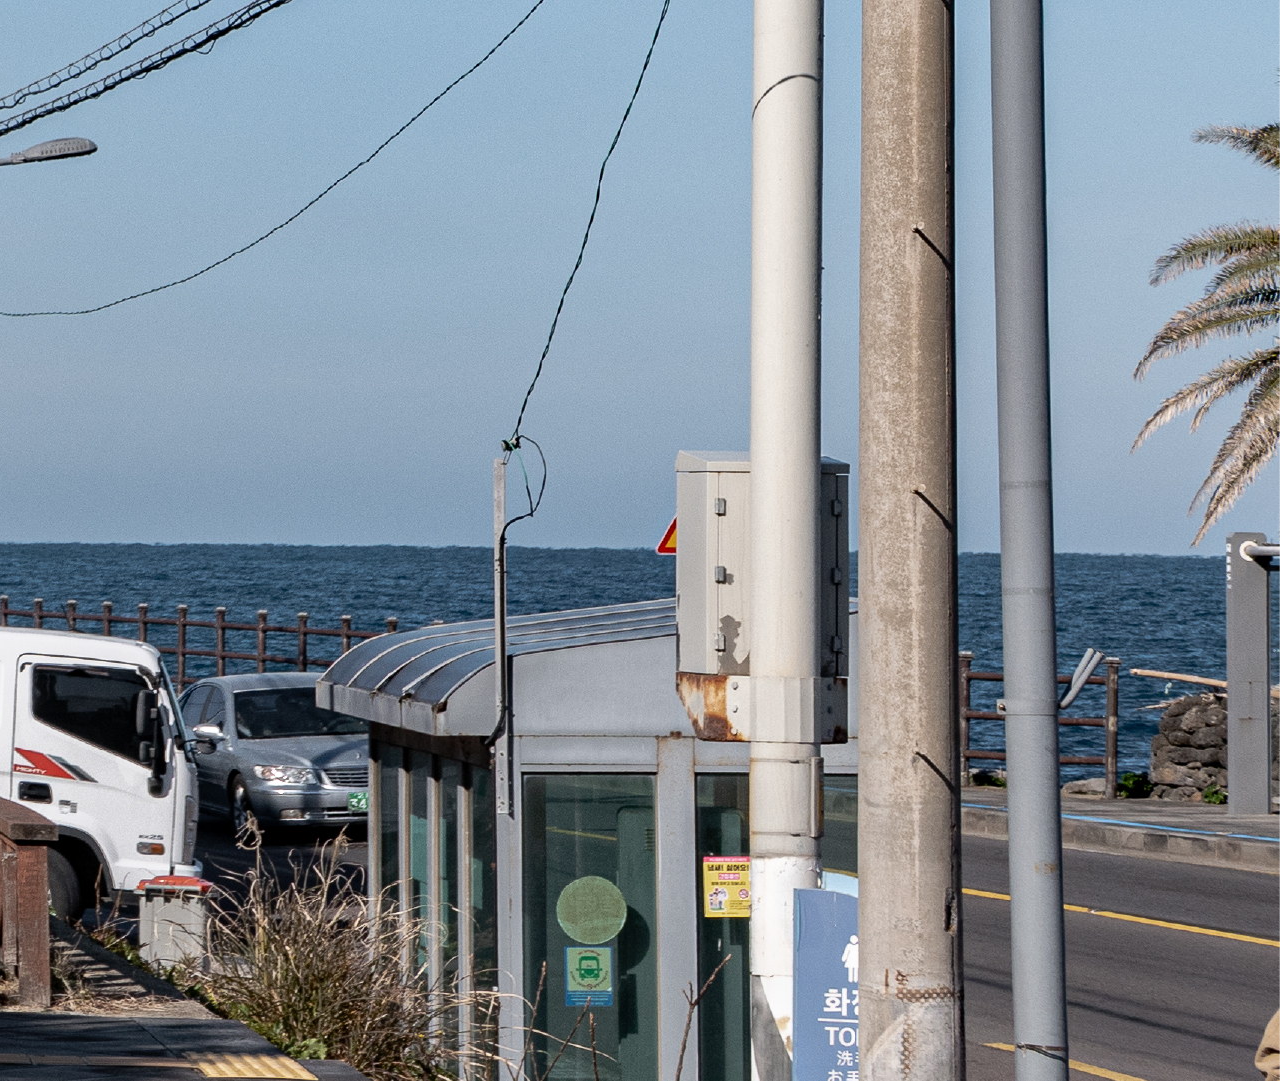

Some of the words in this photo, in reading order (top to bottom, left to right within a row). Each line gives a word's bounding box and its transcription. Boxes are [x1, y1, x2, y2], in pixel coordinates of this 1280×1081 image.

[15, 766, 47, 775] MIGHTY
[823, 987, 859, 1016] 화
[836, 1050, 859, 1067] 洗
